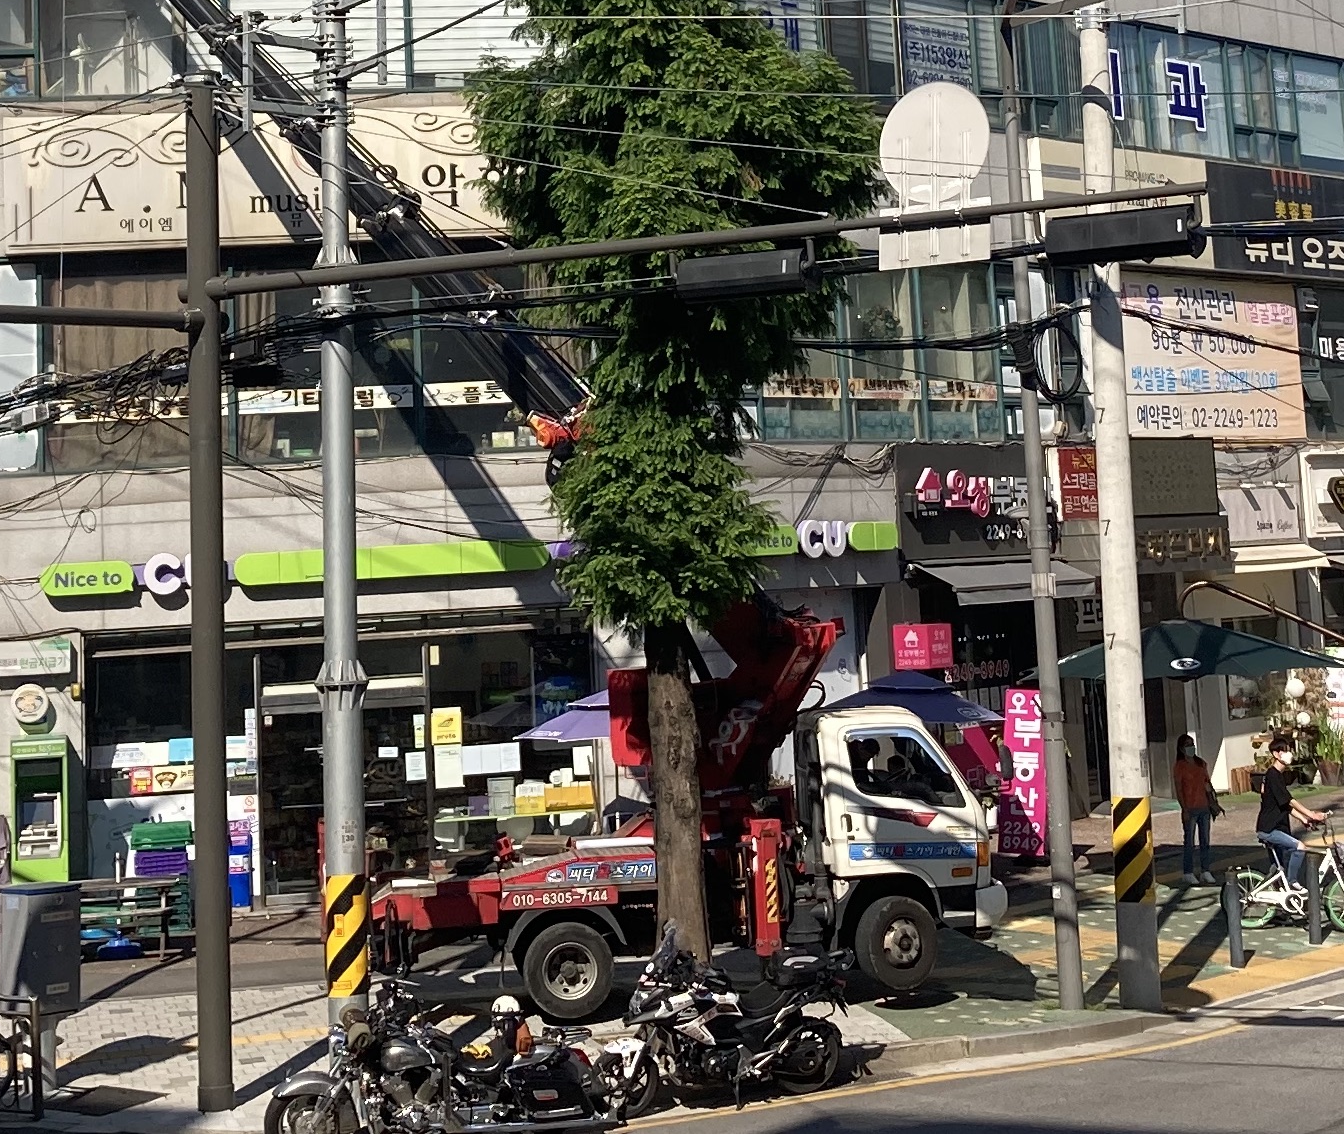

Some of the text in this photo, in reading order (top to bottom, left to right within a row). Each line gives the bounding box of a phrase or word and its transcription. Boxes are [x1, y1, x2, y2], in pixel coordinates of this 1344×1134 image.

[250, 187, 323, 214] musi
[119, 217, 173, 233] 에이엠
[1173, 287, 1238, 323] 전신관리
[1131, 365, 1178, 392] 뱃살탈출
[1181, 368, 1211, 392] 이벤트
[463, 381, 504, 405] 플룻
[1137, 404, 1279, 431] 예약문의: 02-2249-1223
[1062, 472, 1096, 490] 스크린골
[1064, 495, 1099, 514] 골프연습
[781, 534, 793, 548] to
[800, 519, 847, 559] CU
[54, 568, 123, 588] Nice to
[1003, 820, 1042, 837] 2249
[1002, 836, 1041, 852] 8949
[512, 888, 609, 907] 010-6305-7144
